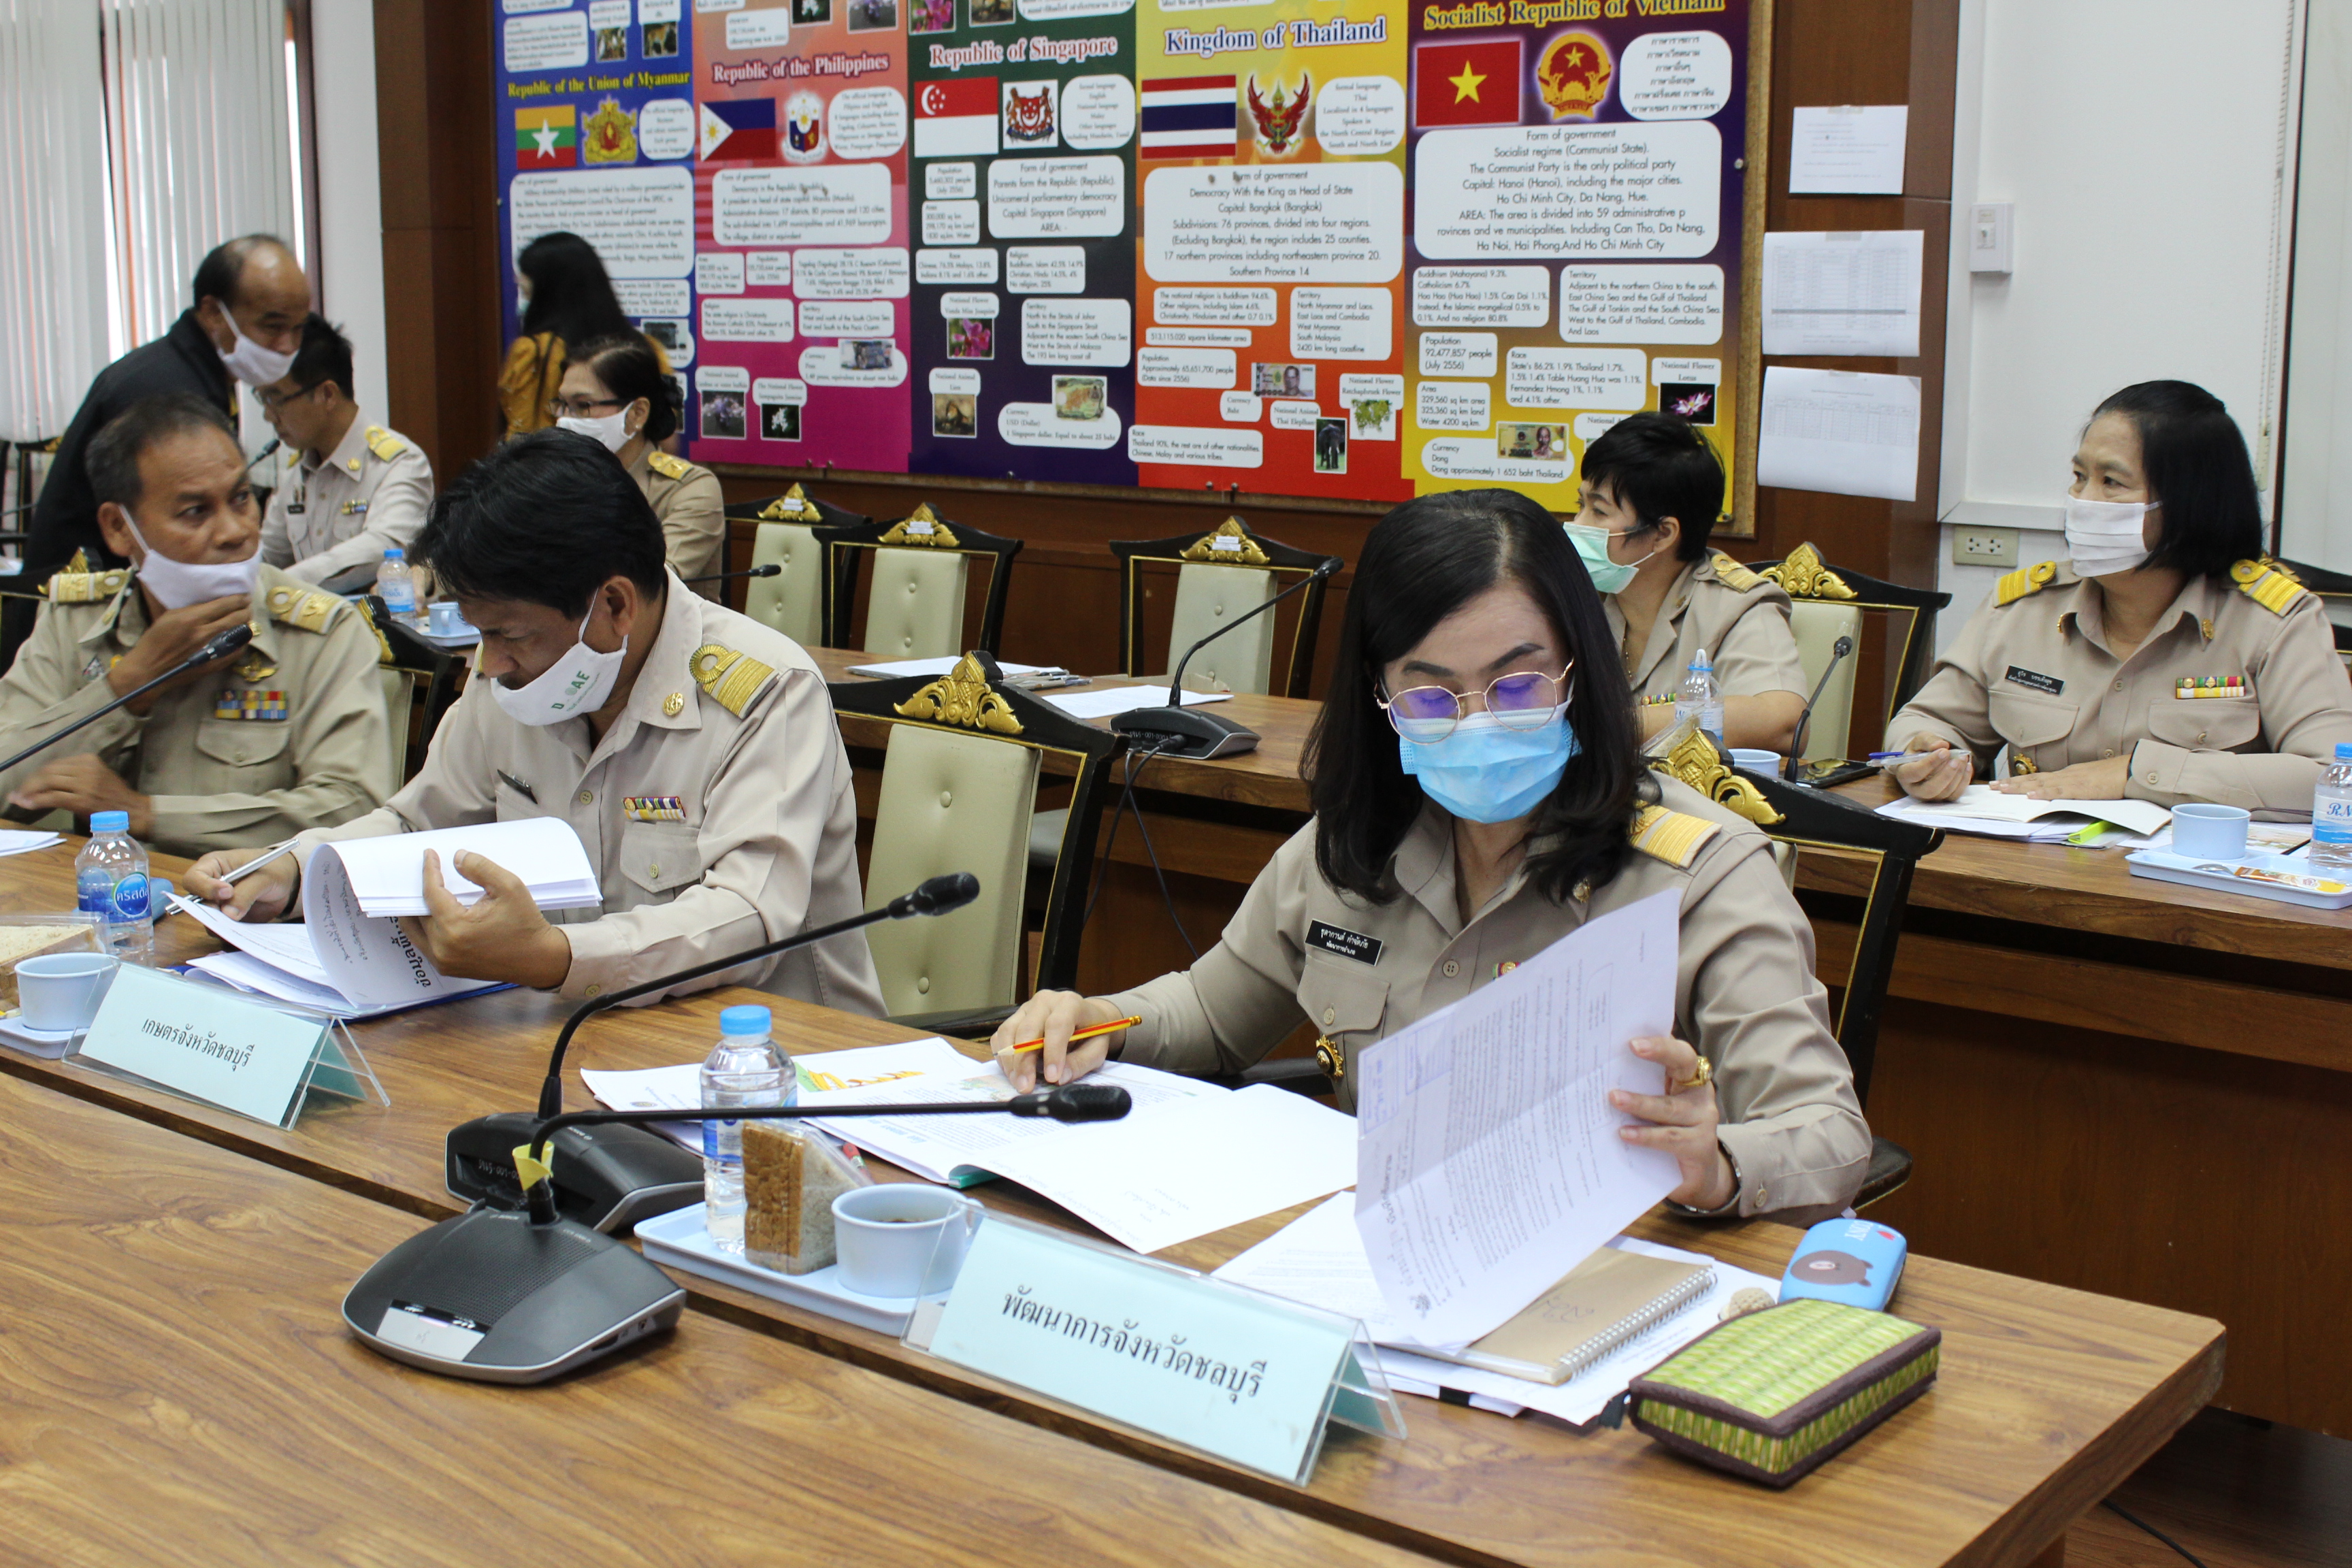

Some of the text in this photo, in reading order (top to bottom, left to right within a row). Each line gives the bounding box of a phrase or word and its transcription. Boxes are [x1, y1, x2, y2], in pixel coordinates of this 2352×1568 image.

[1424, 5, 1505, 30] Socialist
[1509, 0, 1599, 27] Republic
[1605, 0, 1629, 18] of
[1164, 15, 1387, 59] Kingdom of Thailand
[930, 36, 1118, 71] Republic of Singapore
[713, 52, 889, 86] Republic of the Philippines
[508, 71, 690, 99] Republic of the Union of Myanmar
[1526, 128, 1616, 142] Form of government
[1494, 146, 1529, 157] Socialist
[1533, 146, 1563, 159] regime
[1566, 144, 1618, 156] (Communist
[1470, 158, 1676, 174] The Communist Party is the only political party
[1254, 169, 1261, 180] of
[1264, 172, 1308, 182] government
[1499, 178, 1524, 189] Hanoi
[1567, 175, 1607, 189] including
[1610, 174, 1624, 186] the
[1627, 175, 1654, 188] major
[1190, 189, 1230, 199] Democracy
[1233, 186, 1251, 196] With
[1254, 186, 1265, 196] the
[1268, 186, 1285, 198] King
[1300, 184, 1320, 195] Head
[1323, 184, 1330, 195] of
[1334, 185, 1353, 195] State
[1497, 195, 1509, 204] Ho
[1512, 193, 1527, 203] Chi
[1531, 192, 1553, 203] Minh
[1580, 192, 1592, 202] Da
[1250, 201, 1281, 214] Bangkok
[1284, 201, 1322, 214] (Bangkok)
[1489, 209, 1504, 219] The
[1531, 210, 1537, 218] is
[1541, 208, 1573, 218] divided
[1577, 209, 1593, 218] into
[1597, 208, 1609, 218] 59
[1613, 206, 1676, 218] administrative
[1222, 219, 1232, 229] 76
[1274, 218, 1302, 228] divided
[1305, 219, 1319, 228] into
[1322, 216, 1337, 227] four
[1437, 227, 1471, 235] rovinces
[1474, 224, 1490, 235] and
[1571, 223, 1610, 237] Including
[1614, 223, 1633, 233] Can
[1659, 223, 1672, 233] Da
[1172, 235, 1209, 247] (Excluding
[1250, 234, 1262, 244] the
[1264, 235, 1288, 246] region
[1292, 233, 1322, 244] includes
[1325, 234, 1335, 244] 25
[1477, 241, 1489, 250] Ha
[1515, 241, 1529, 250] Hai
[1585, 240, 1597, 250] Ho
[1601, 238, 1616, 250] Chi
[1620, 238, 1643, 249] Minh
[1646, 239, 1665, 252] City
[1165, 251, 1173, 259] 17
[1177, 250, 1206, 260] northern
[1209, 252, 1243, 262] provinces
[1246, 250, 1279, 263] including
[1282, 250, 1328, 260] northeastern
[1331, 251, 1365, 262] province
[1230, 266, 1309, 276] Southern Province 14
[142, 1017, 255, 1073] เกษตรจังหวัดชลบุรี
[1001, 1286, 1268, 1404] พัฒนาการจังหวัดชลบุรี
